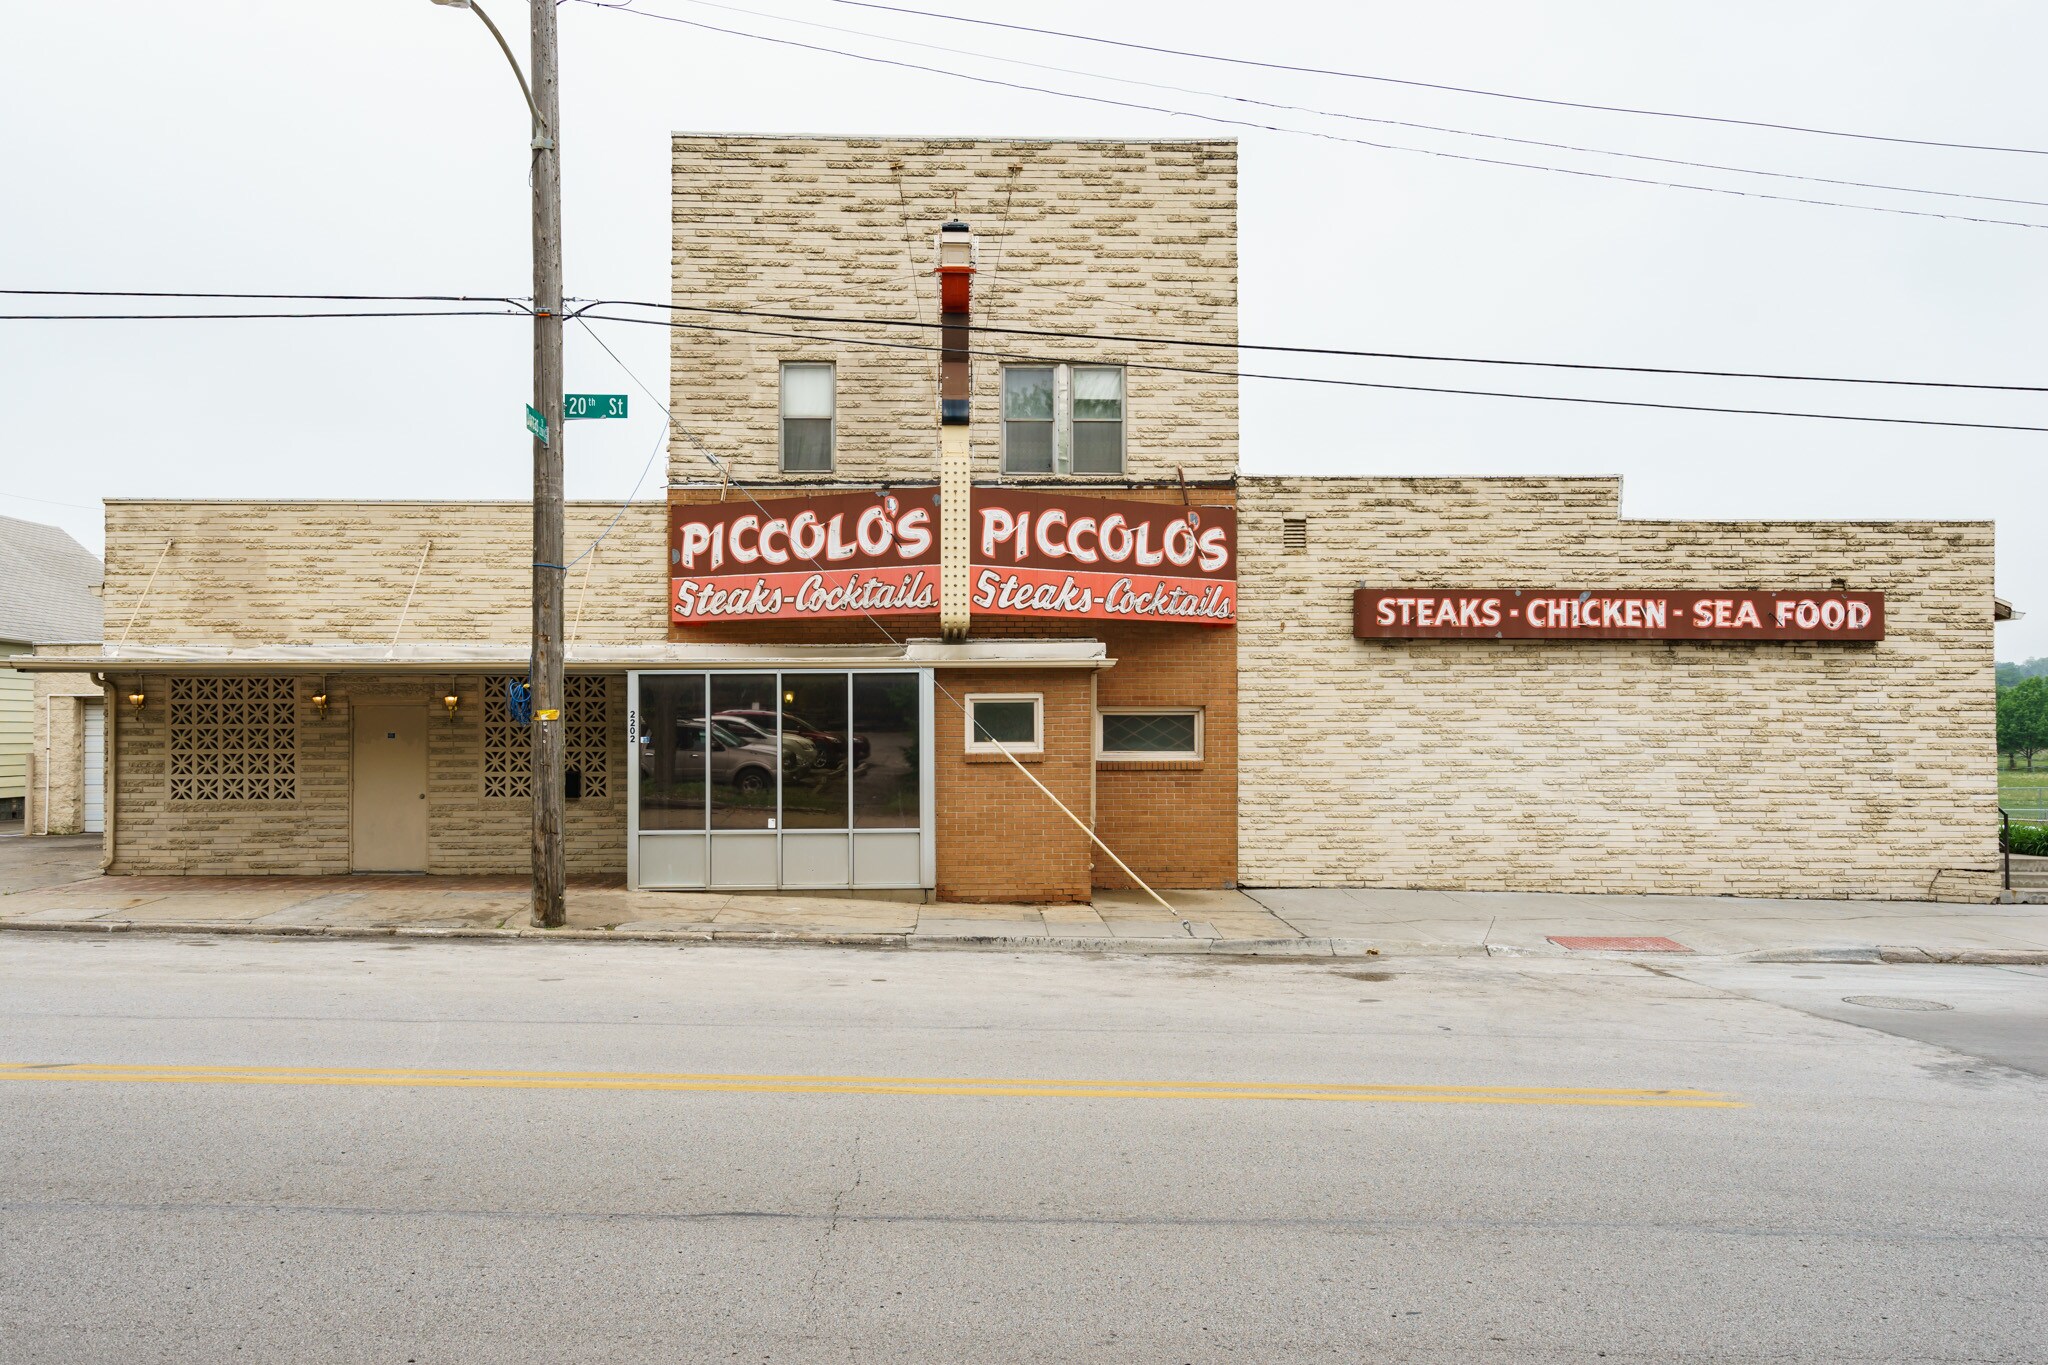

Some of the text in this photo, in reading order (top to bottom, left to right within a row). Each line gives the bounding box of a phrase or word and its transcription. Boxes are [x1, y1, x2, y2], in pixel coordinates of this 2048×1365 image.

[569, 397, 624, 416] 20th St
[680, 495, 933, 571] PICCOLO'S
[978, 506, 1229, 573] PICCOLO'S
[1376, 598, 1502, 627] STEAKS
[1525, 598, 1667, 629] CHICKEN
[1692, 599, 1763, 629] SEA
[1775, 599, 1872, 630] FOOD
